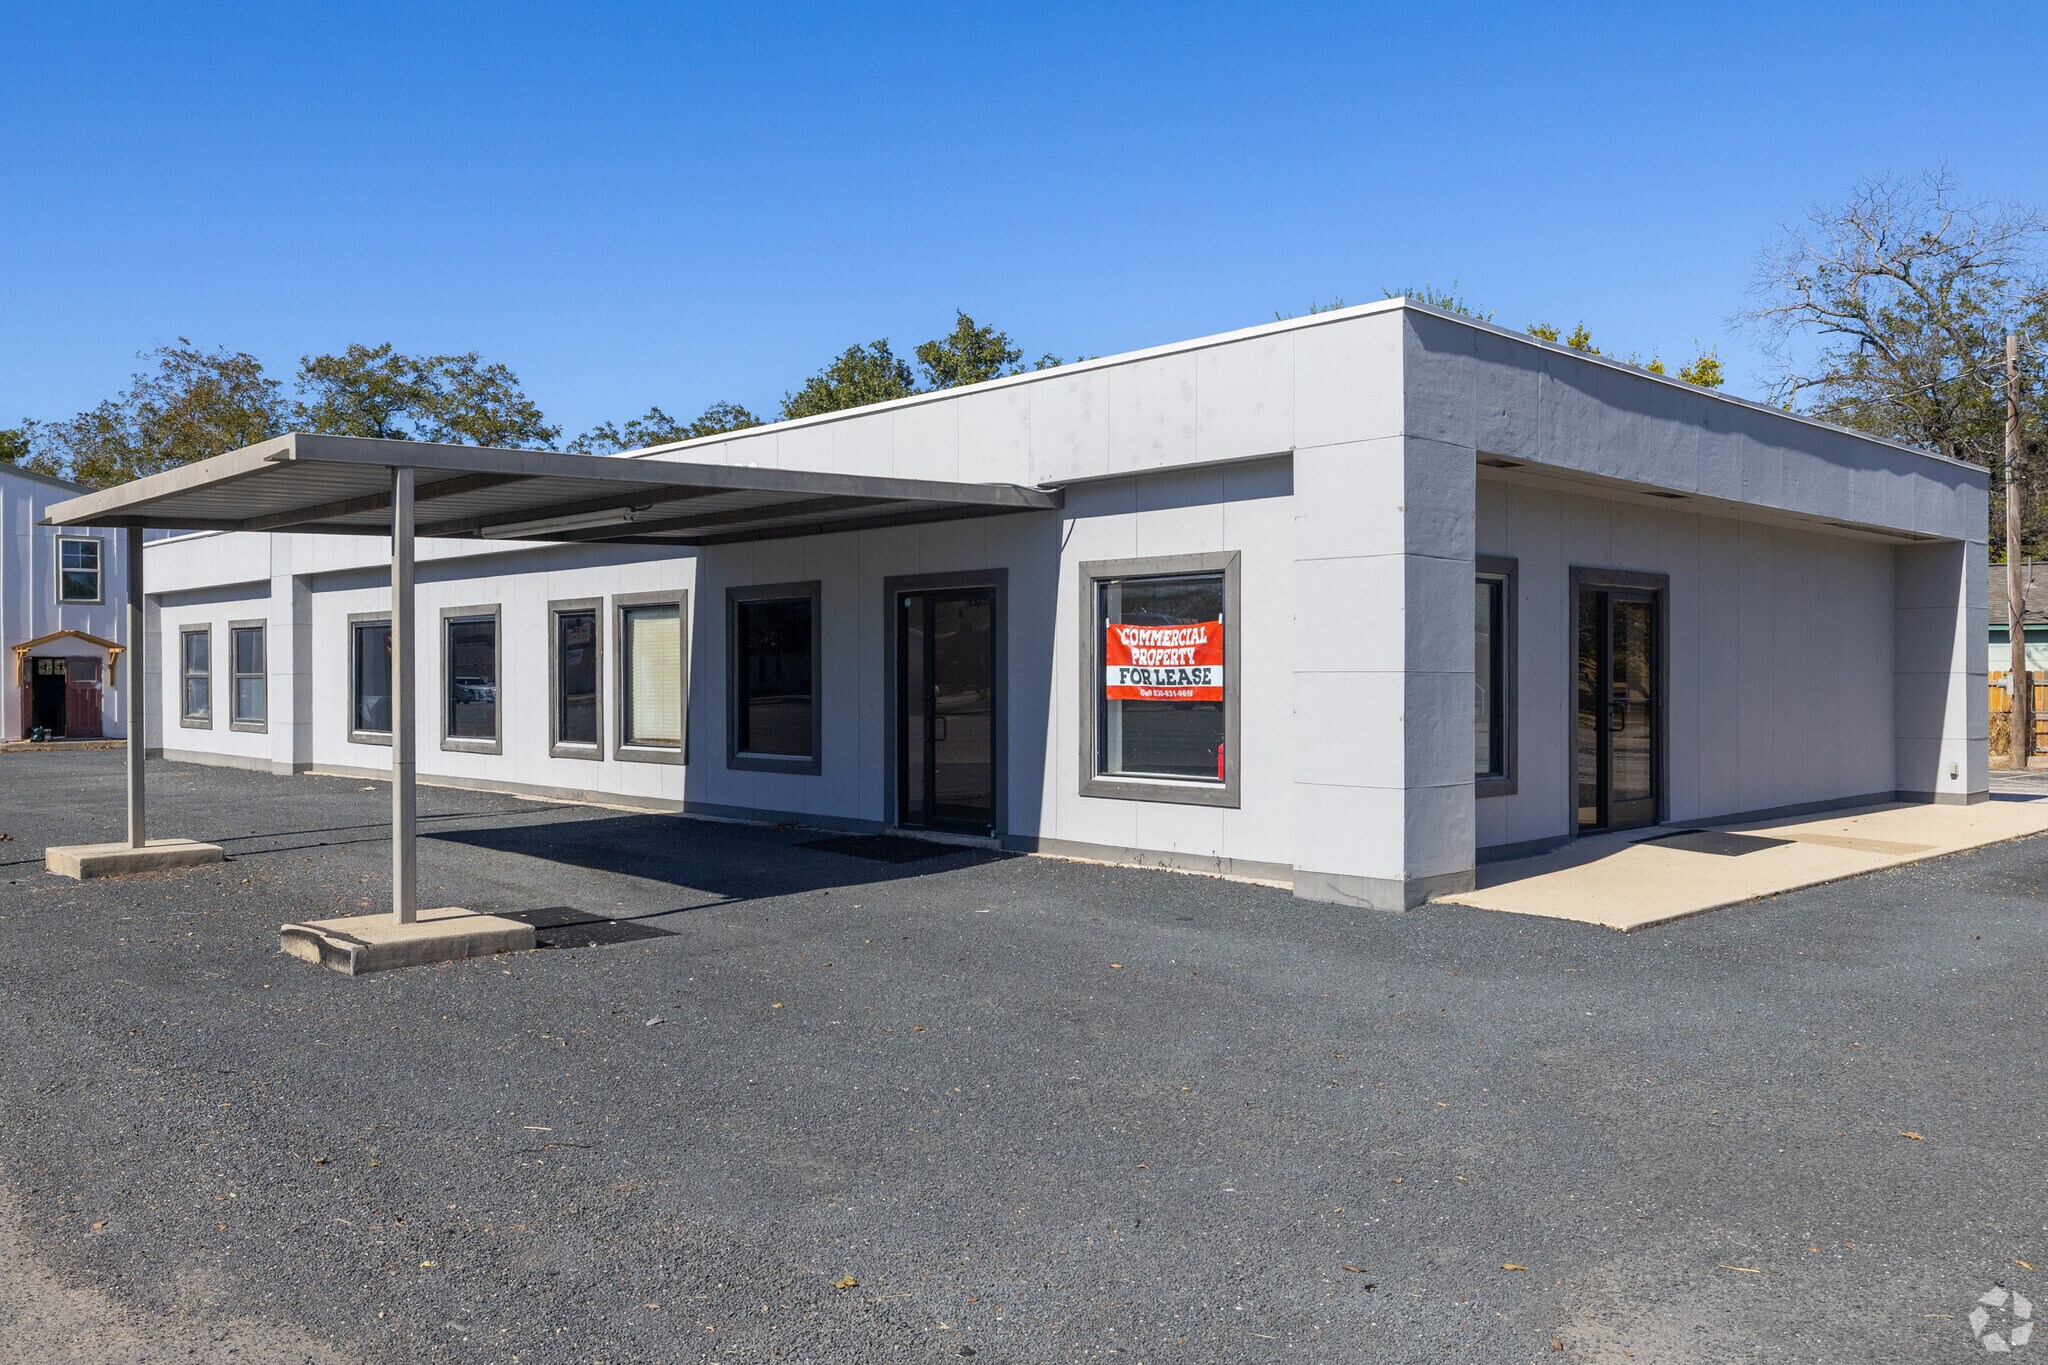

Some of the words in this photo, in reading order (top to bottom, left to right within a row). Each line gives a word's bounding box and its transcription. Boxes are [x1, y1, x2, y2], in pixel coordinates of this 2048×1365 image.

[1120, 626, 1208, 646] COMMERCIAL
[1131, 647, 1195, 666] PROPERTY
[1119, 668, 1152, 685] FOR
[1154, 668, 1212, 685] LEASE
[1140, 689, 1152, 697] Call
